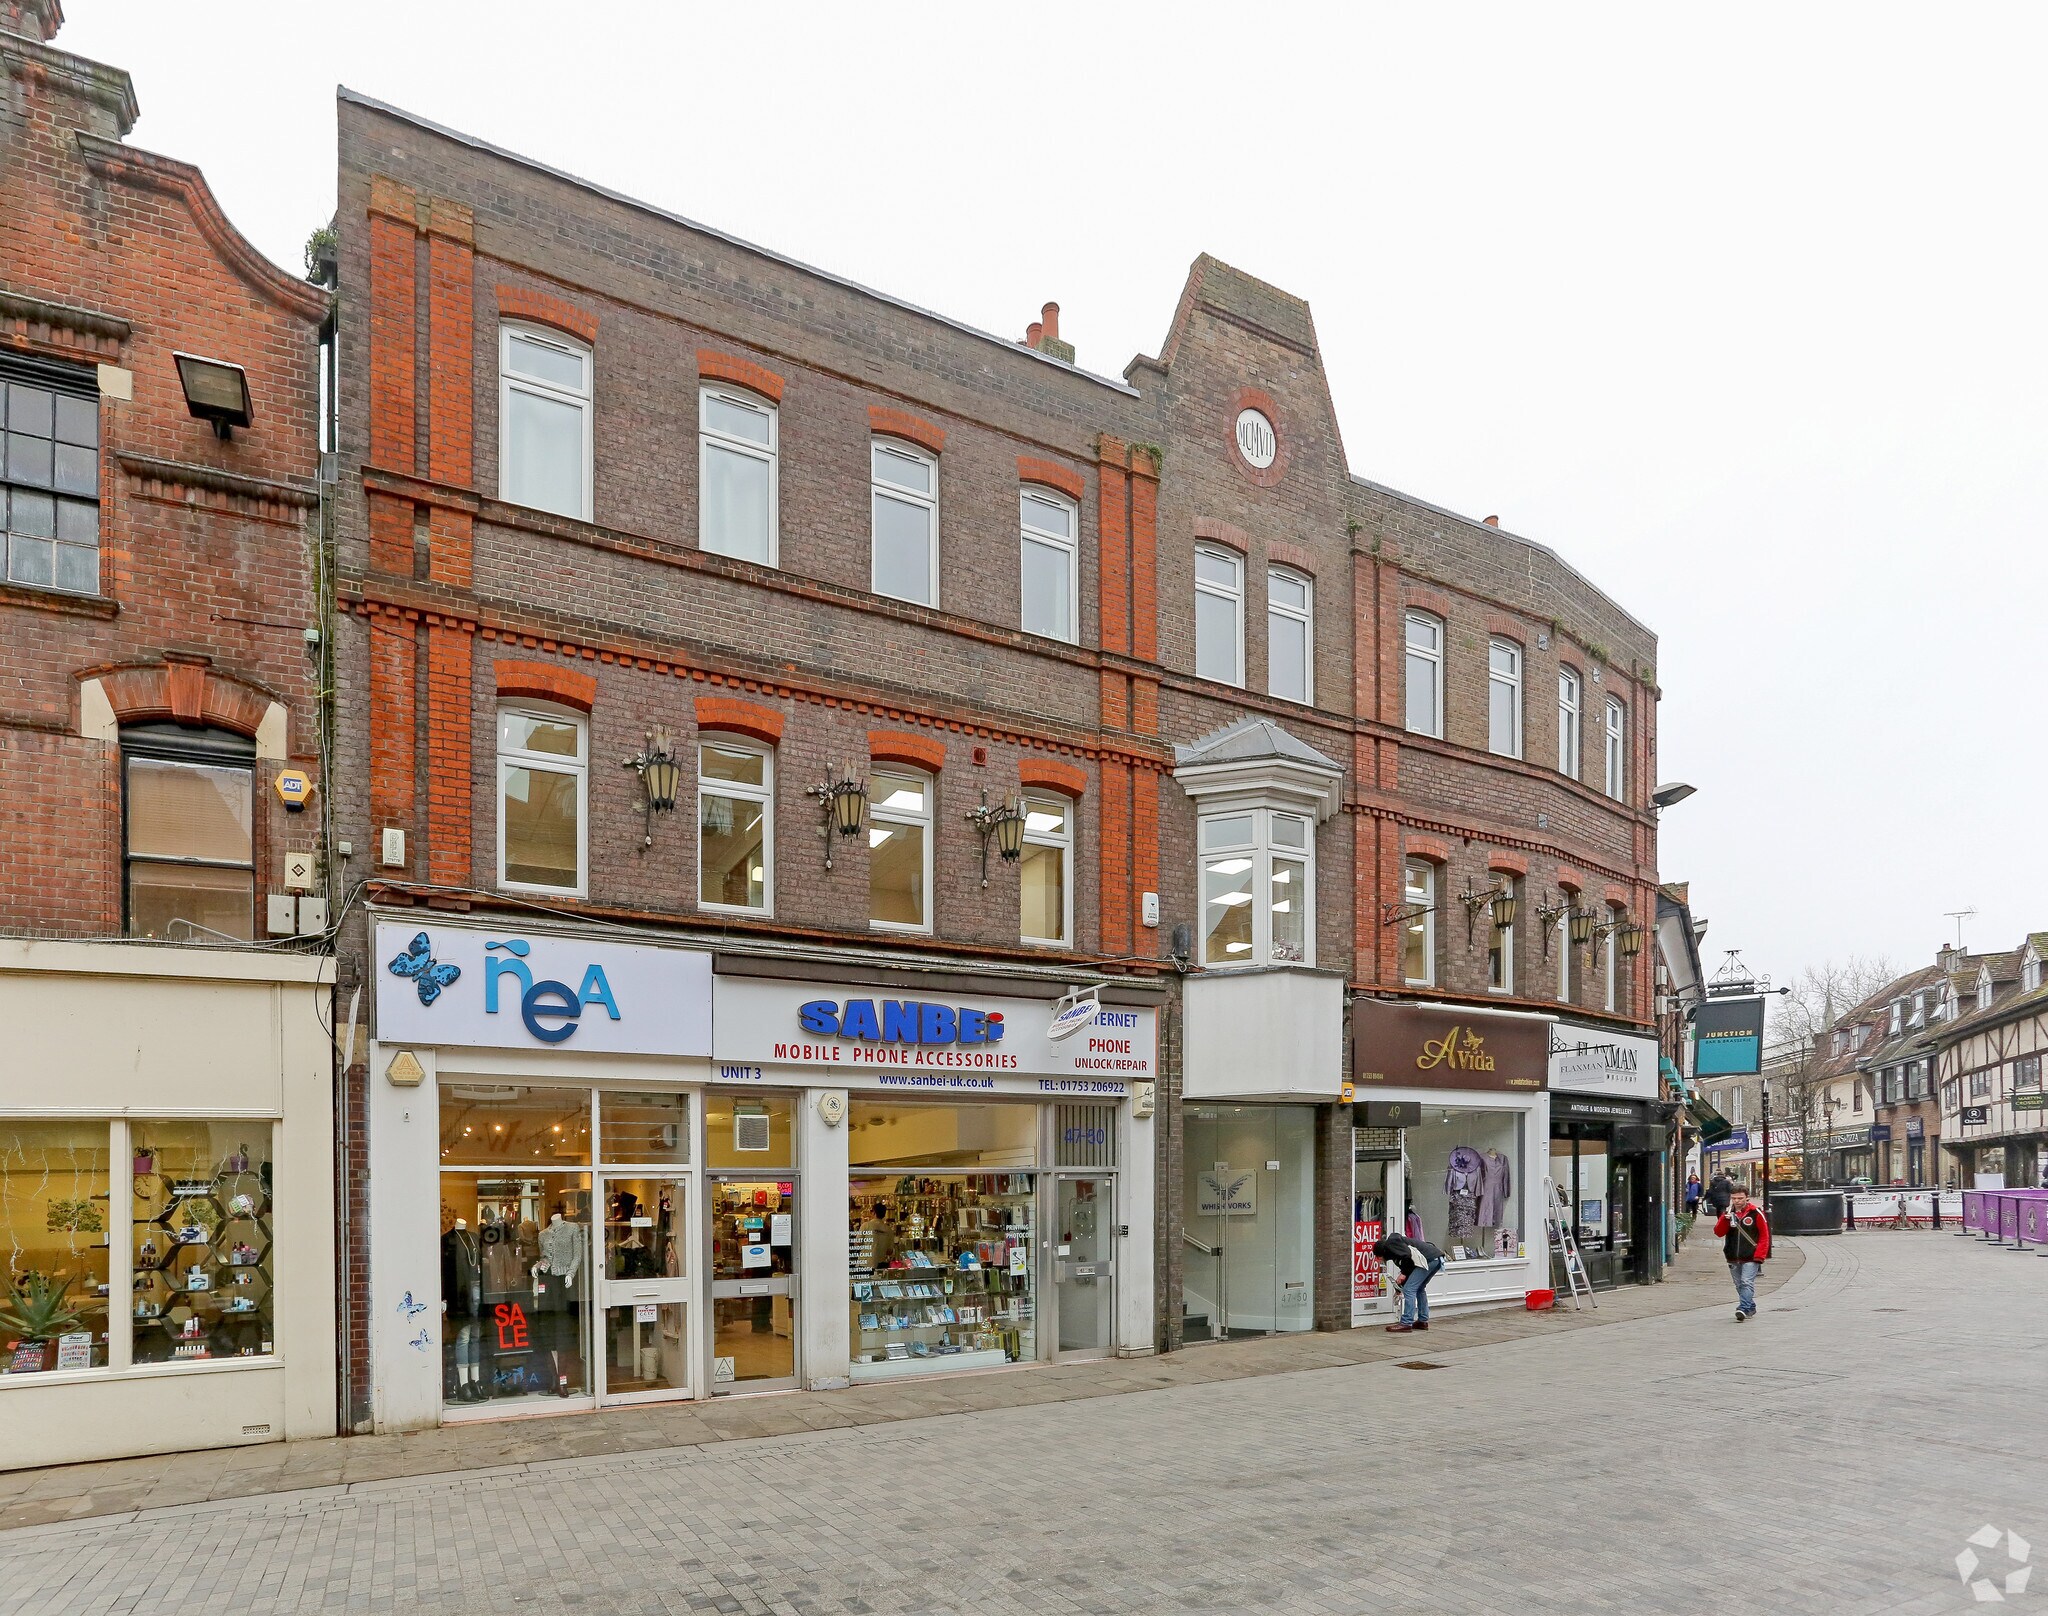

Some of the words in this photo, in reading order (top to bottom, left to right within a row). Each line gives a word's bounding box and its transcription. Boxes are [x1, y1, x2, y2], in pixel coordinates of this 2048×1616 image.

[283, 779, 302, 791] ADT
[1089, 1012, 1138, 1027] TERNET
[1705, 1030, 1753, 1039] JUNCTION
[1089, 1038, 1131, 1053] PHONE
[774, 1043, 840, 1061] MOBILE
[853, 1047, 908, 1065] PHONE
[915, 1050, 1018, 1069] ACCESSORIES
[1075, 1058, 1147, 1071] UNLOCK/REPAIR
[1560, 1061, 1603, 1073] FLAXMAN
[721, 1065, 751, 1079] UNIT
[754, 1067, 761, 1079] 3
[879, 1074, 994, 1088] www.sanbei-uk.co.uk
[1039, 1079, 1058, 1091] TEL:
[1060, 1080, 1089, 1092] 01753
[1091, 1081, 1124, 1092] 206922
[1388, 1105, 1401, 1119] 49
[1571, 1104, 1589, 1112] ANTIQUE
[1594, 1106, 1610, 1114] MODERN
[1611, 1106, 1632, 1115] JEWELLERY
[1064, 1128, 1105, 1145] 47-50
[1356, 1224, 1380, 1243] SALE
[1355, 1251, 1379, 1271] 70%
[1355, 1272, 1379, 1283] OFF
